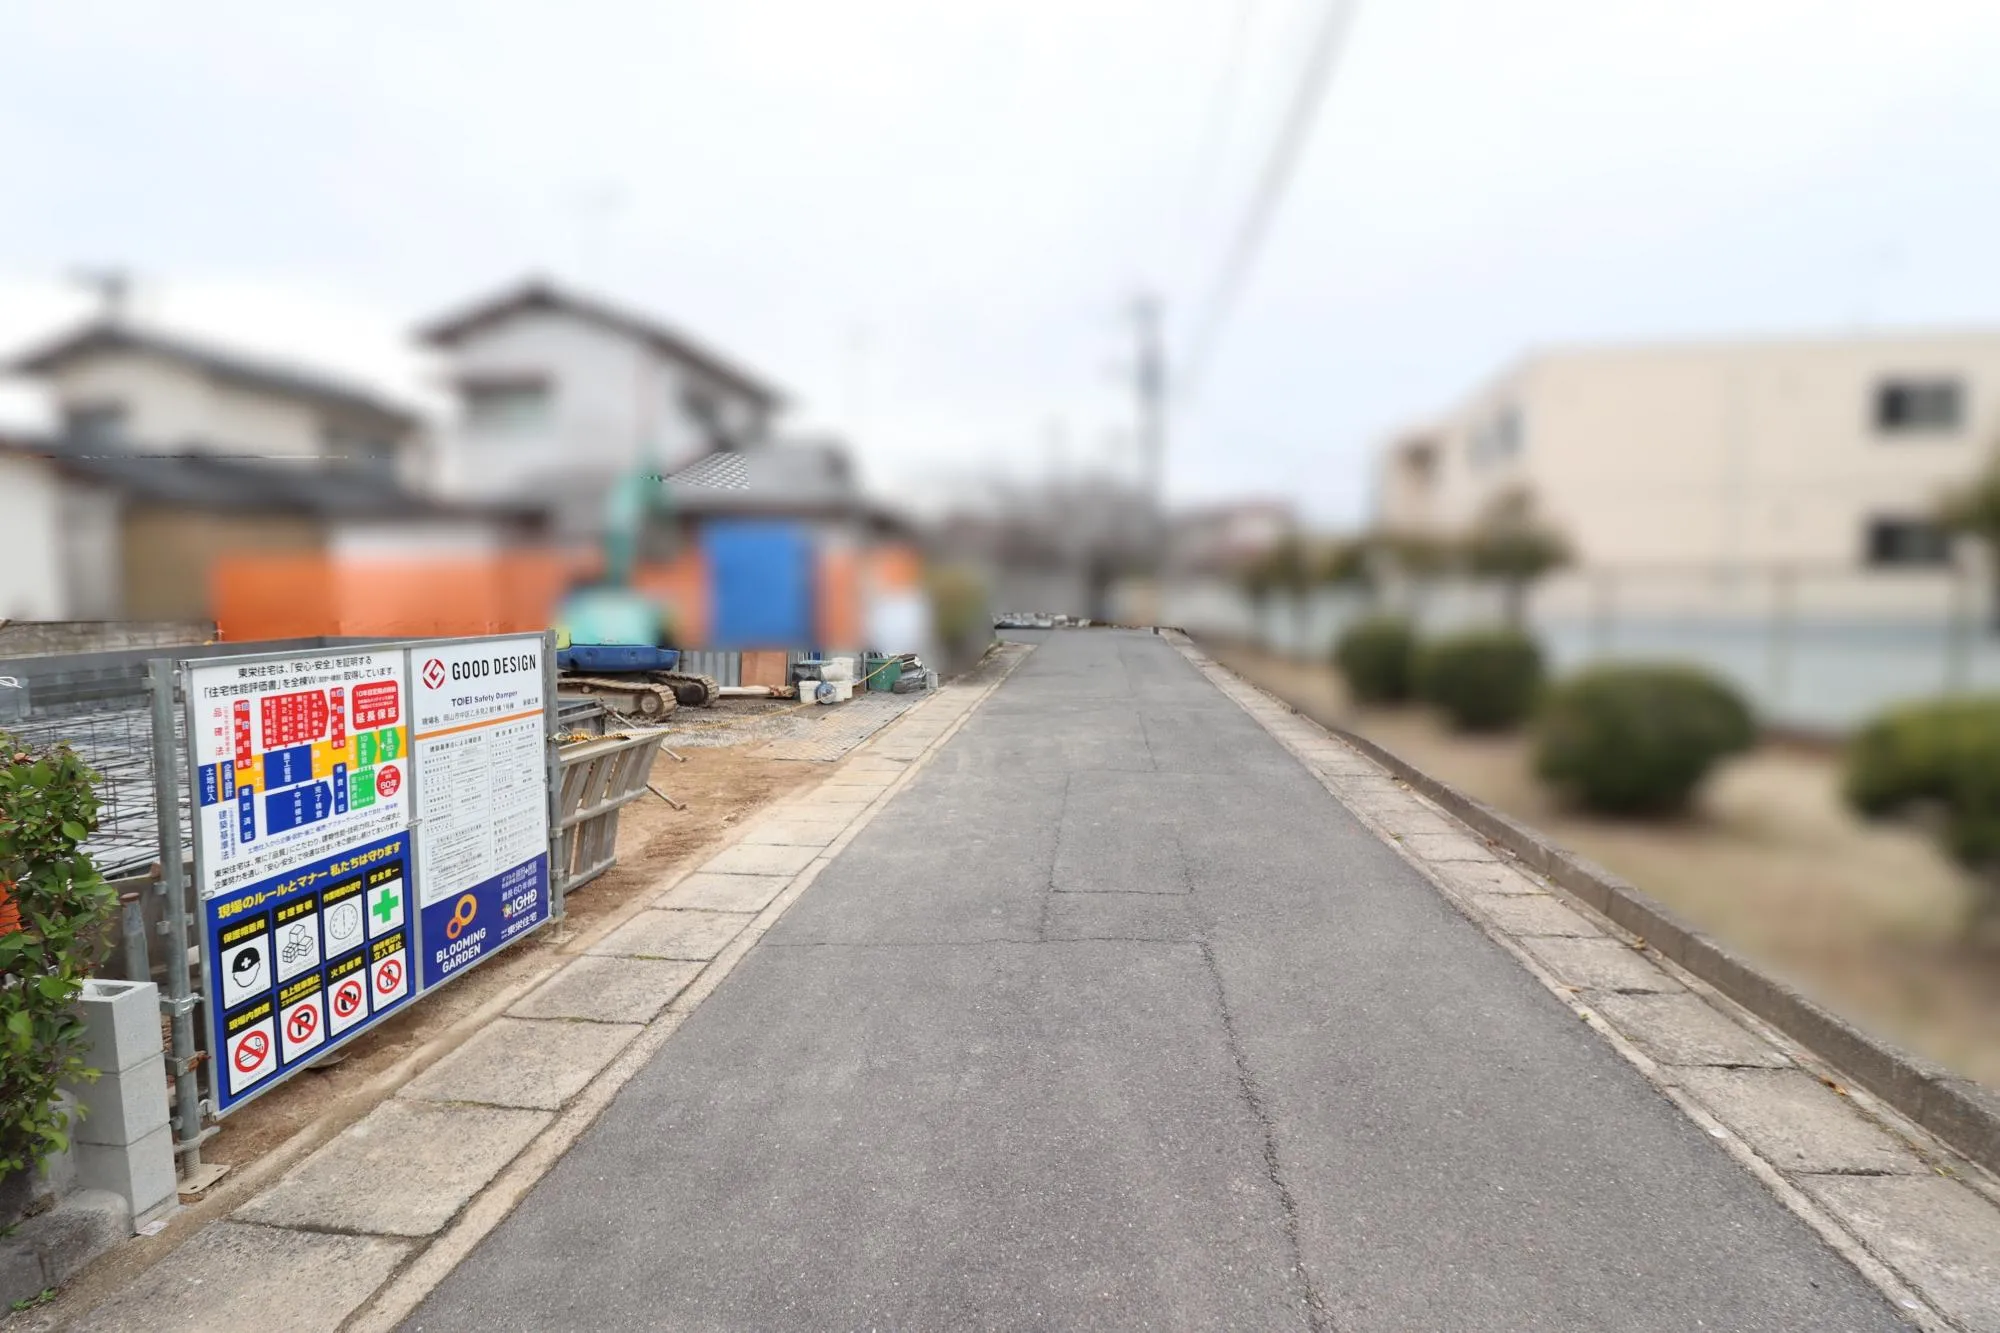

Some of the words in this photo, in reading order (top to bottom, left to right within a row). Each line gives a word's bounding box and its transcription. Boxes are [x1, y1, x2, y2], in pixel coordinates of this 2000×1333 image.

[452, 660, 490, 680] GOOD
[494, 654, 536, 675] DESIGN
[474, 694, 495, 704] Safety
[496, 690, 518, 700] Damper
[217, 867, 328, 920] 現場のルールとマナー
[329, 840, 401, 877] 私たちは守ります
[436, 928, 486, 963] BLOOMING
[442, 943, 481, 973] GARDEN
